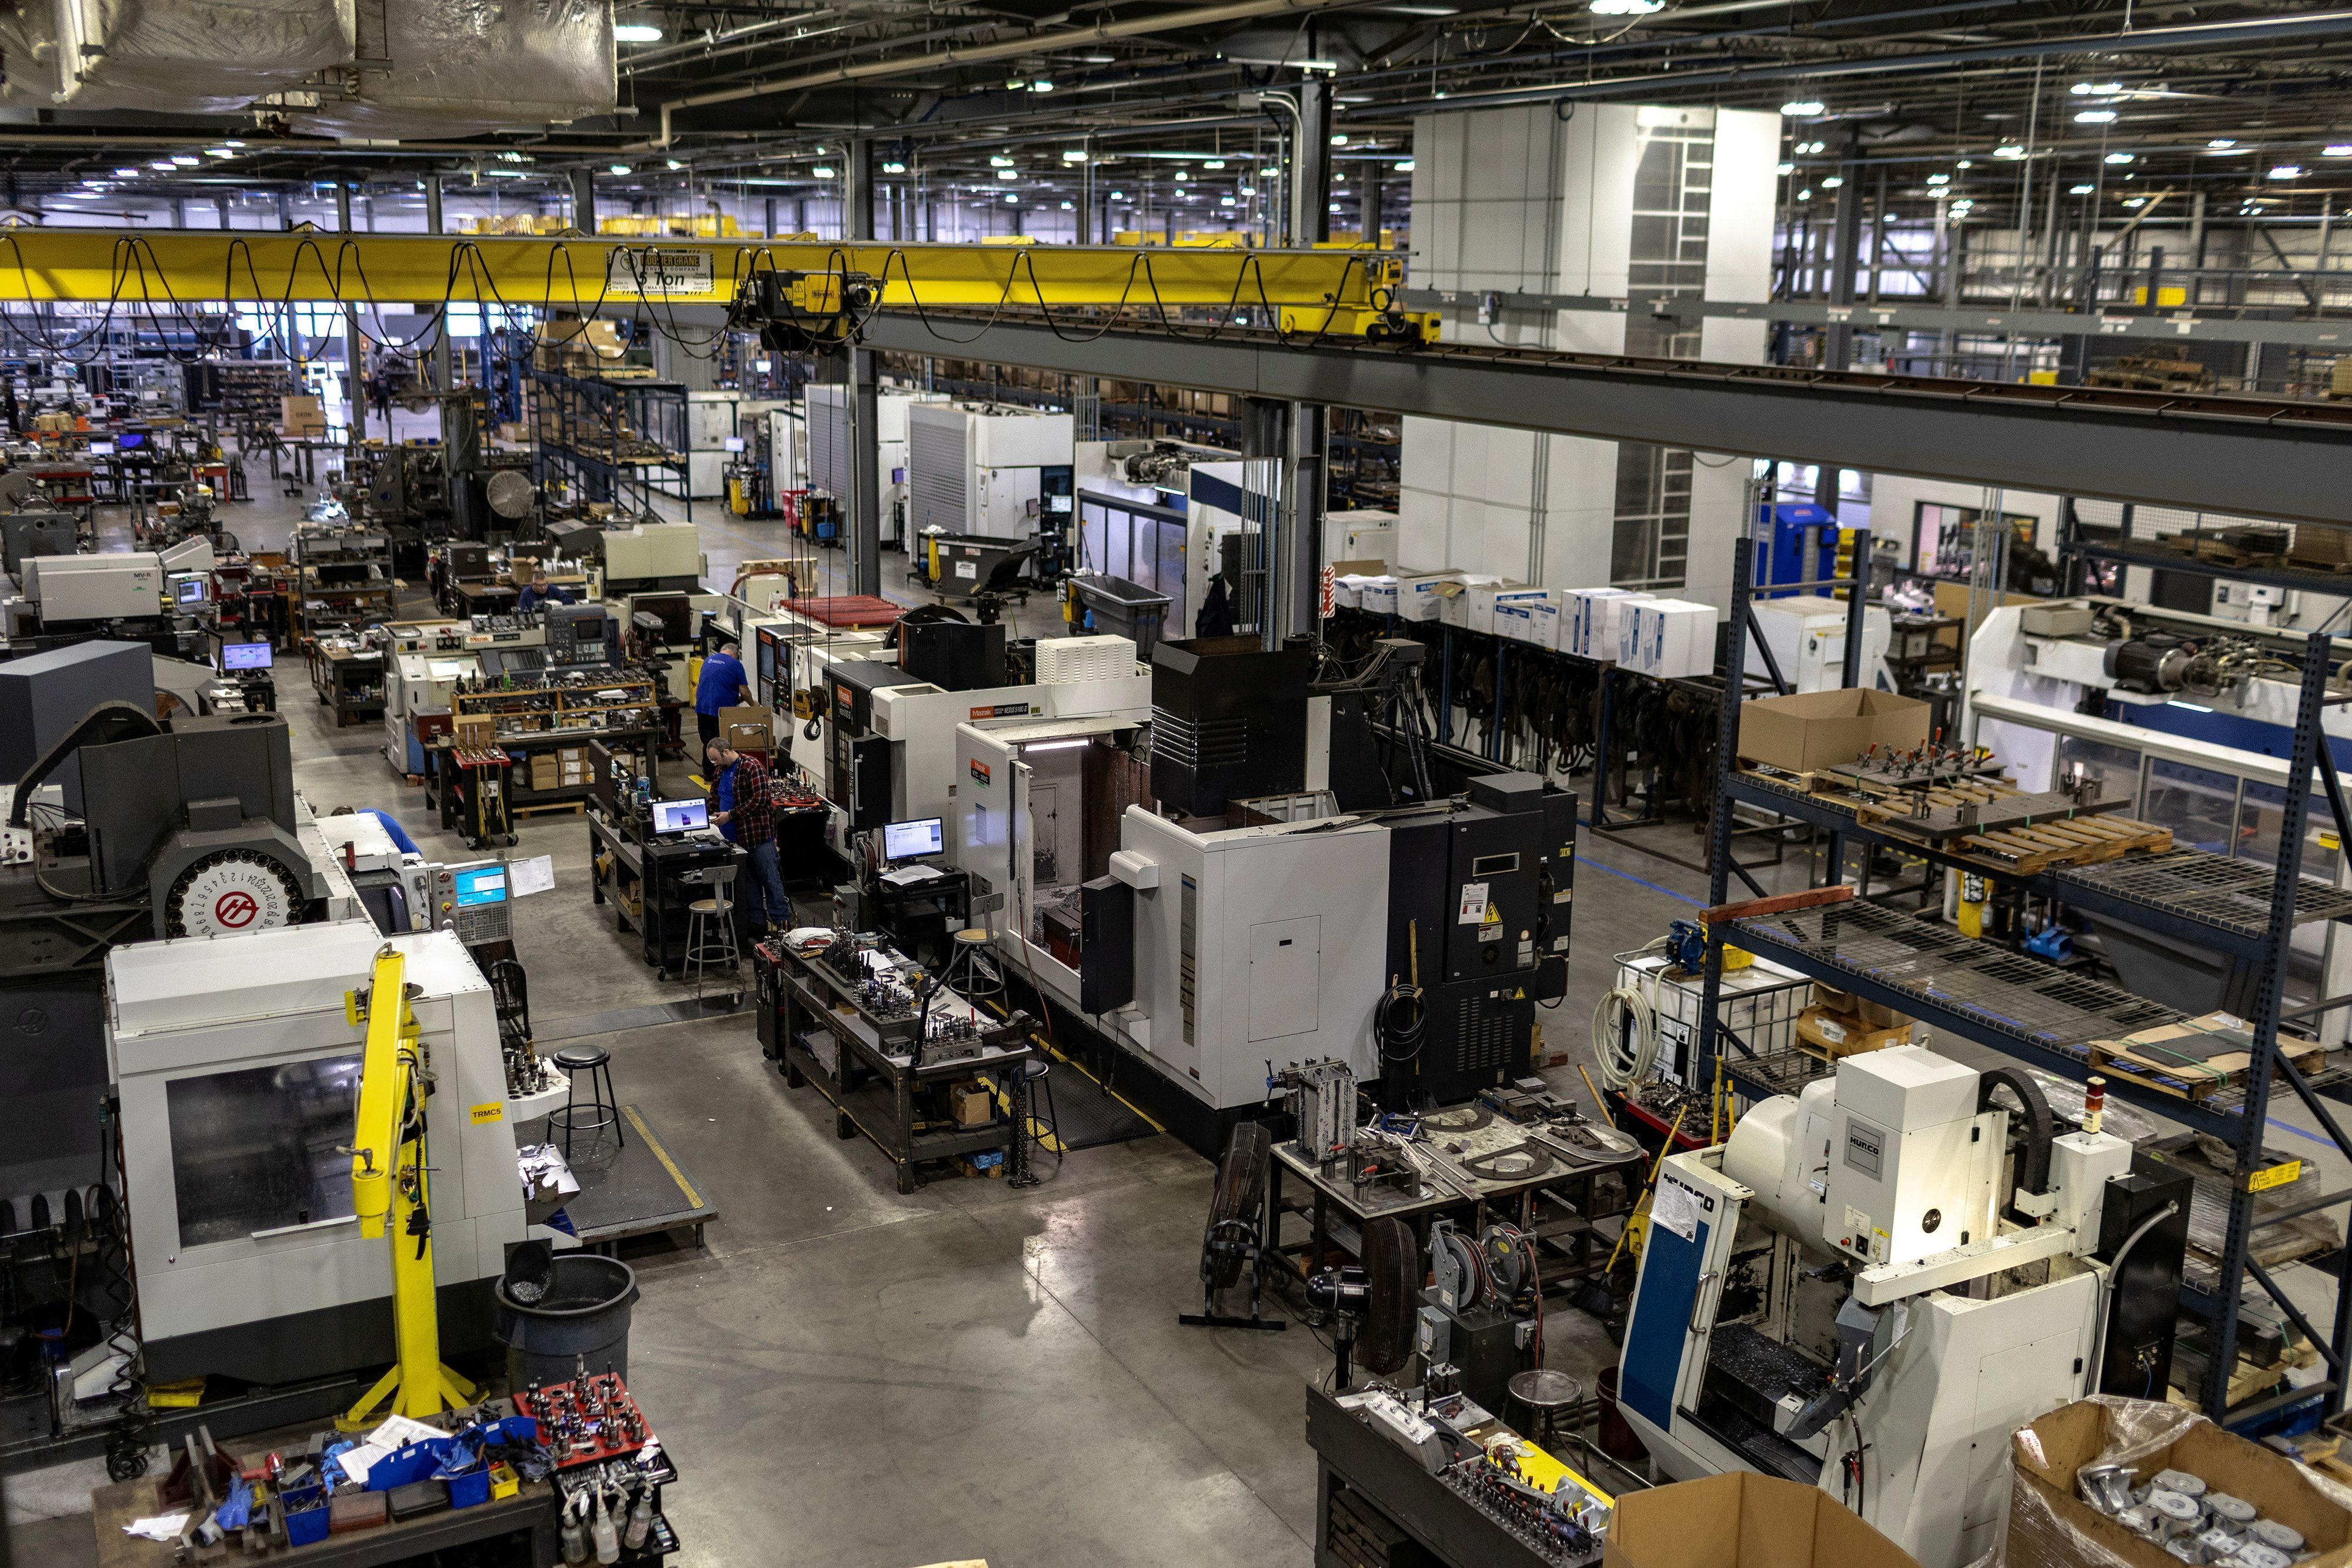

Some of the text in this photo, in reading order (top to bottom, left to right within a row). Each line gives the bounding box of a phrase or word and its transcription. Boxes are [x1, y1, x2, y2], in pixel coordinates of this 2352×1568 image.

[674, 255, 700, 266] CRANE
[654, 272, 684, 285] Ton
[220, 875, 227, 884] 3
[231, 872, 236, 881] 2
[473, 1108, 501, 1118] TRMC5
[1850, 1136, 1879, 1155] HURCO
